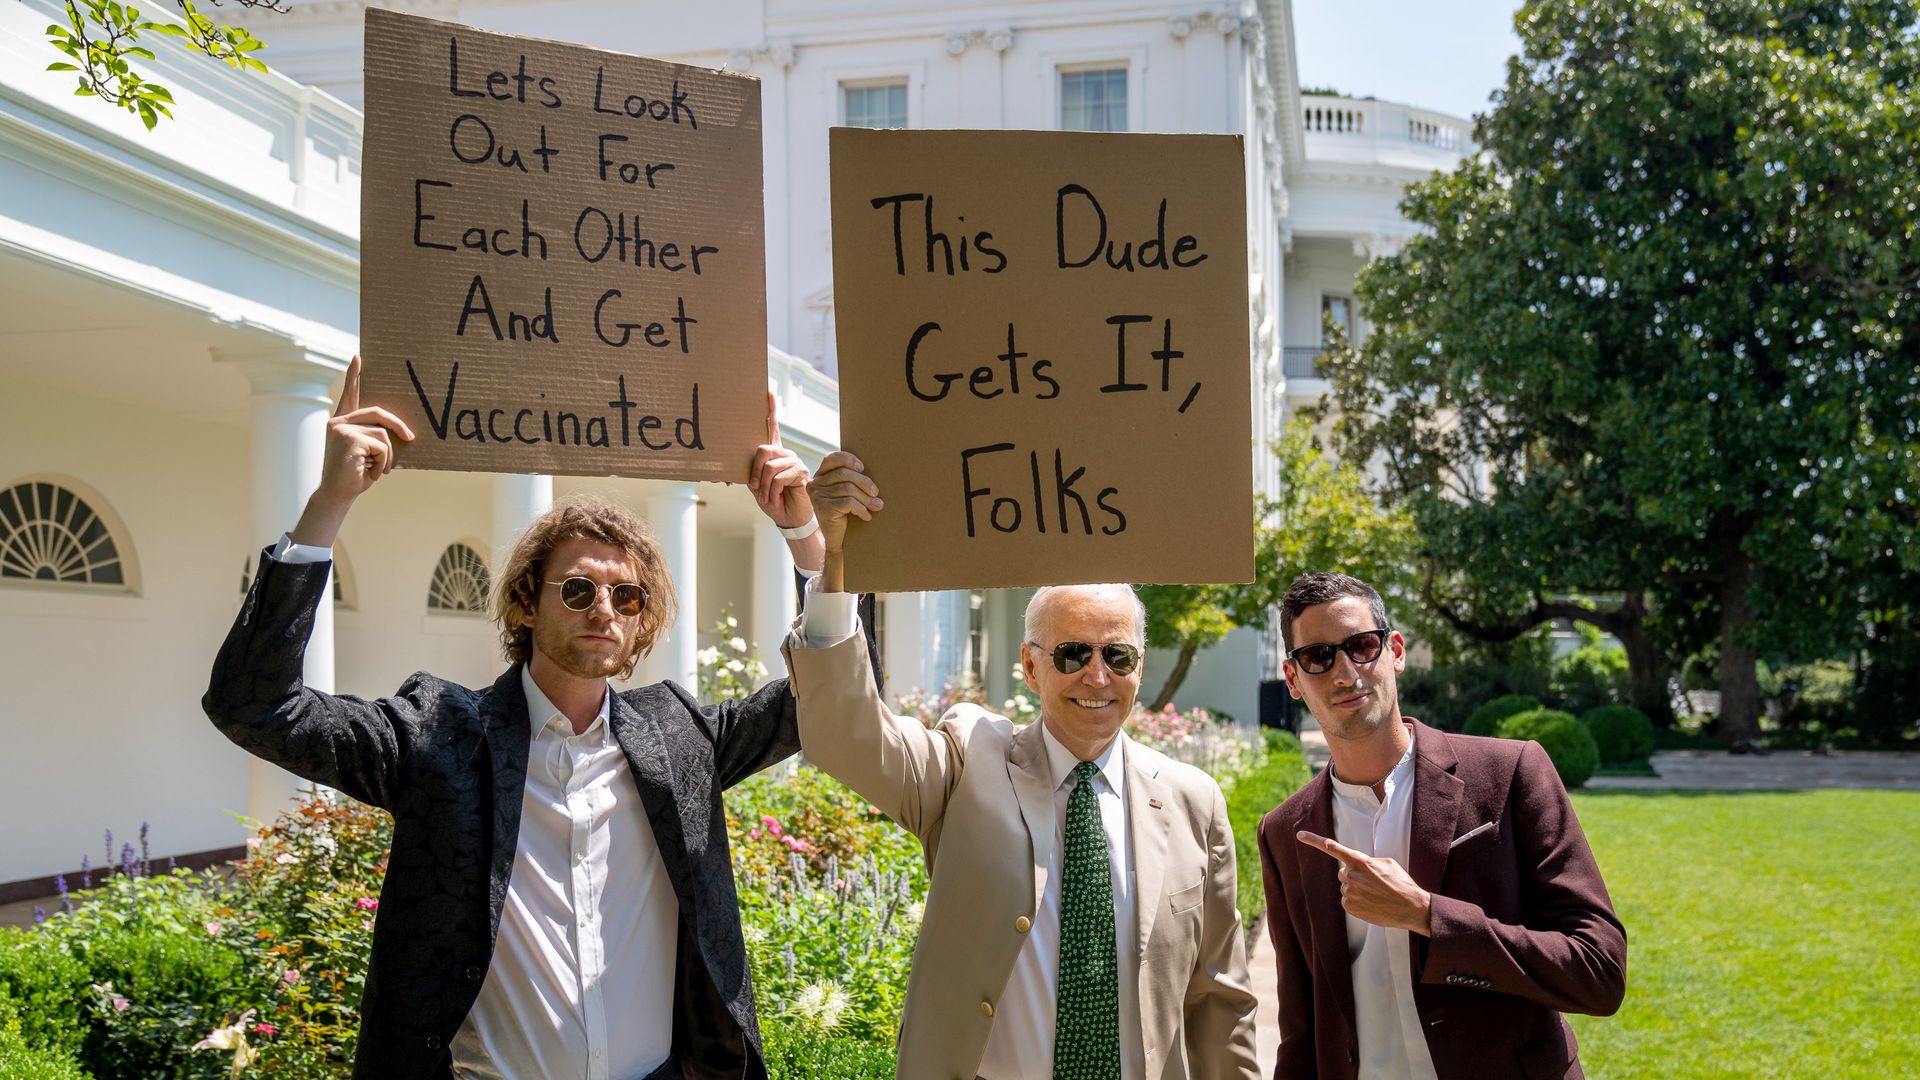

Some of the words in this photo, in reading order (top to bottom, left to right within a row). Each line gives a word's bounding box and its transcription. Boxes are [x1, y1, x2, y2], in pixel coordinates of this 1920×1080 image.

[450, 37, 562, 108] Lets
[594, 66, 697, 130] Look
[450, 114, 559, 173] Out
[599, 134, 675, 189] For
[414, 179, 547, 260] Each
[574, 207, 719, 275] Other
[871, 193, 1007, 275] This
[1057, 184, 1208, 272] Dude
[457, 275, 559, 343] And
[594, 289, 697, 353] Get
[406, 360, 704, 450] Vaccinated
[906, 322, 1060, 402] Gets
[1100, 315, 1201, 413] It,
[961, 443, 1126, 537] Folks
